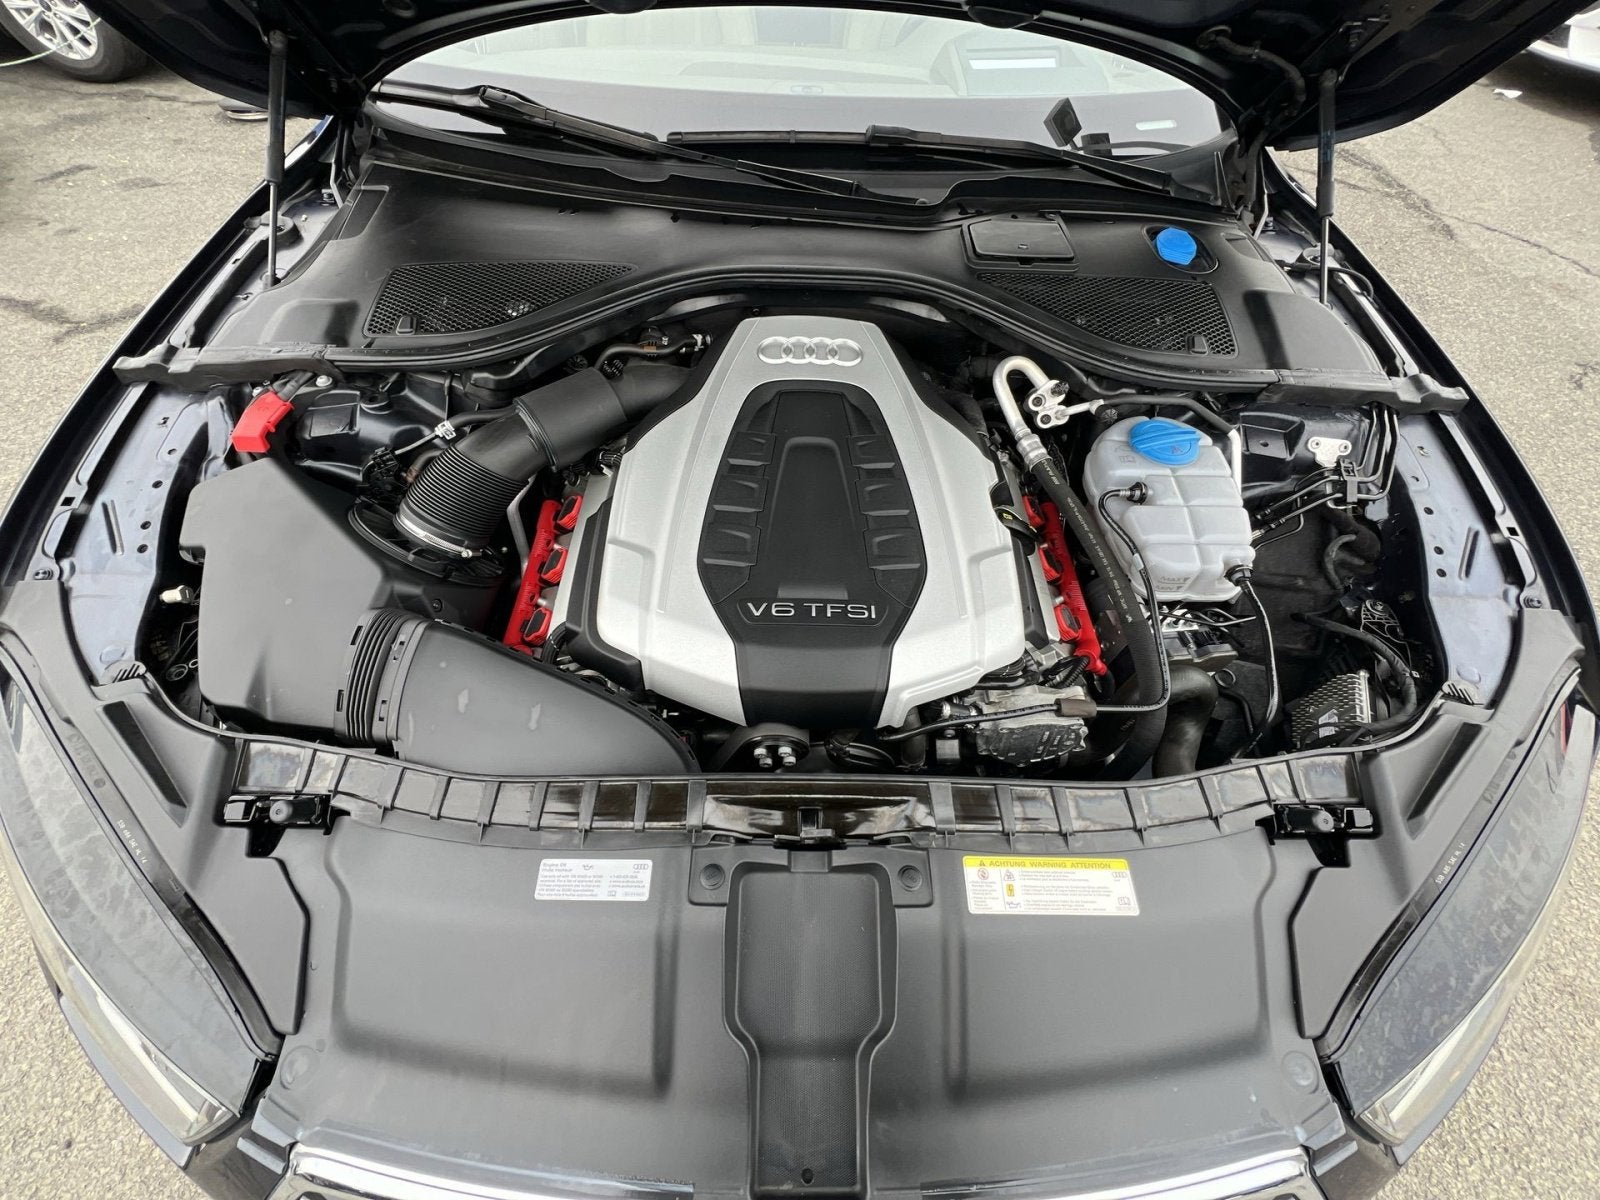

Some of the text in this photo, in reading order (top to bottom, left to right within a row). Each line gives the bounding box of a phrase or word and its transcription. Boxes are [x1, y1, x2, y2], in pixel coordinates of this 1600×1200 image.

[747, 602, 876, 619] V6 TFSI
[988, 860, 1026, 868] ACHTUNG
[1070, 861, 1111, 869] ATTENTION
